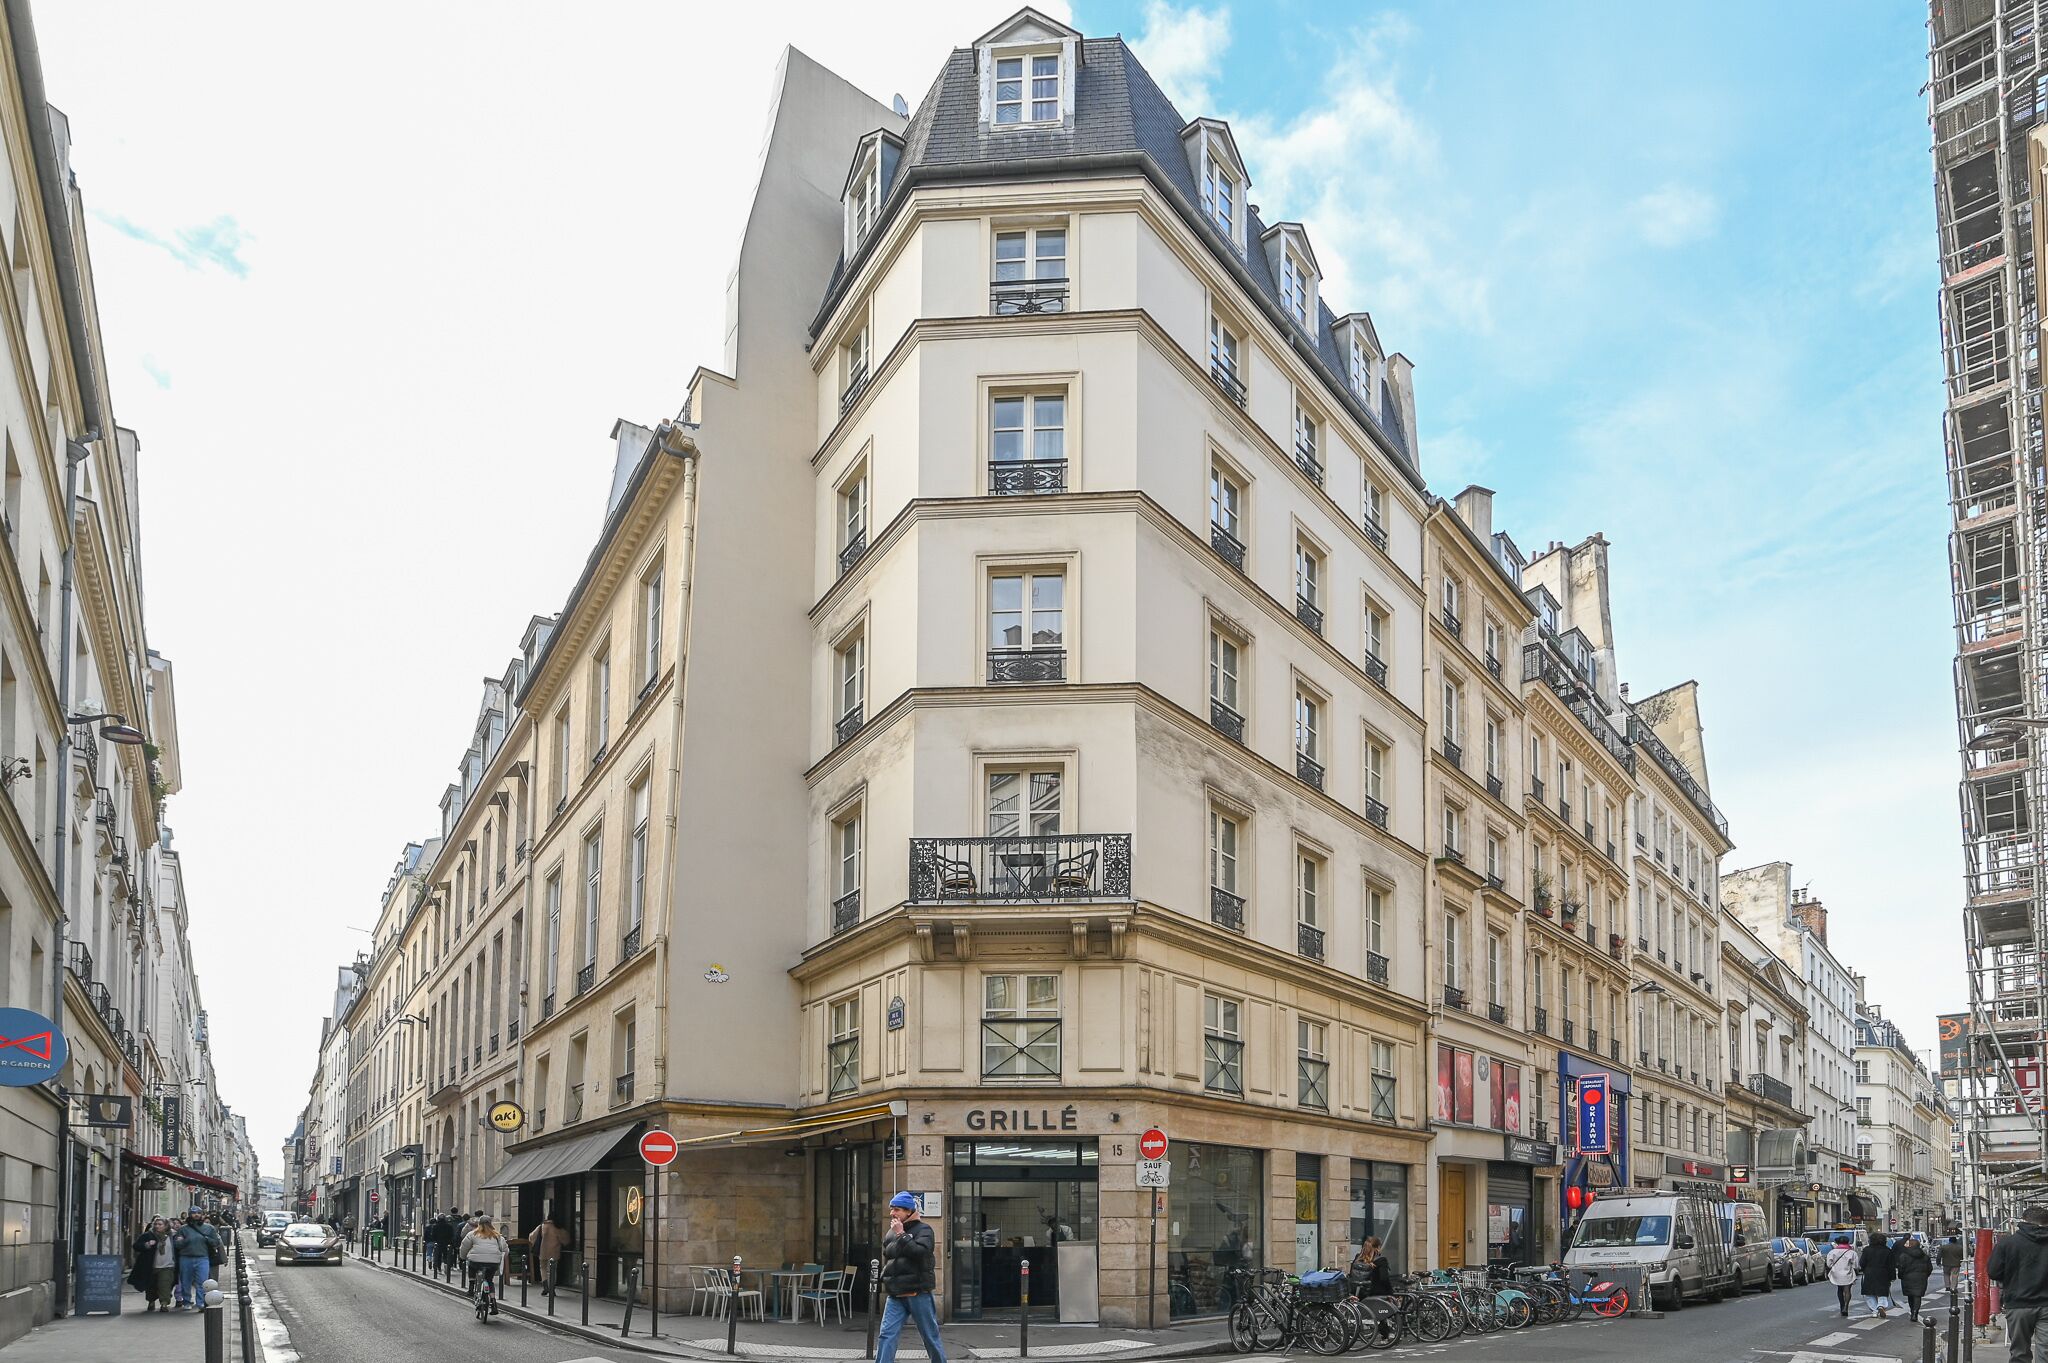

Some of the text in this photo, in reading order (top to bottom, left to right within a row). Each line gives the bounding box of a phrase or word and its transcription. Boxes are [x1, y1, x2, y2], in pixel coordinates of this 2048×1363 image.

[10, 1060, 51, 1069] GARDEN
[966, 1104, 1077, 1130] GRILLÉ
[1589, 1105, 1597, 1144] OKINAWA
[921, 1144, 931, 1157] 15
[1112, 1144, 1122, 1156] 15
